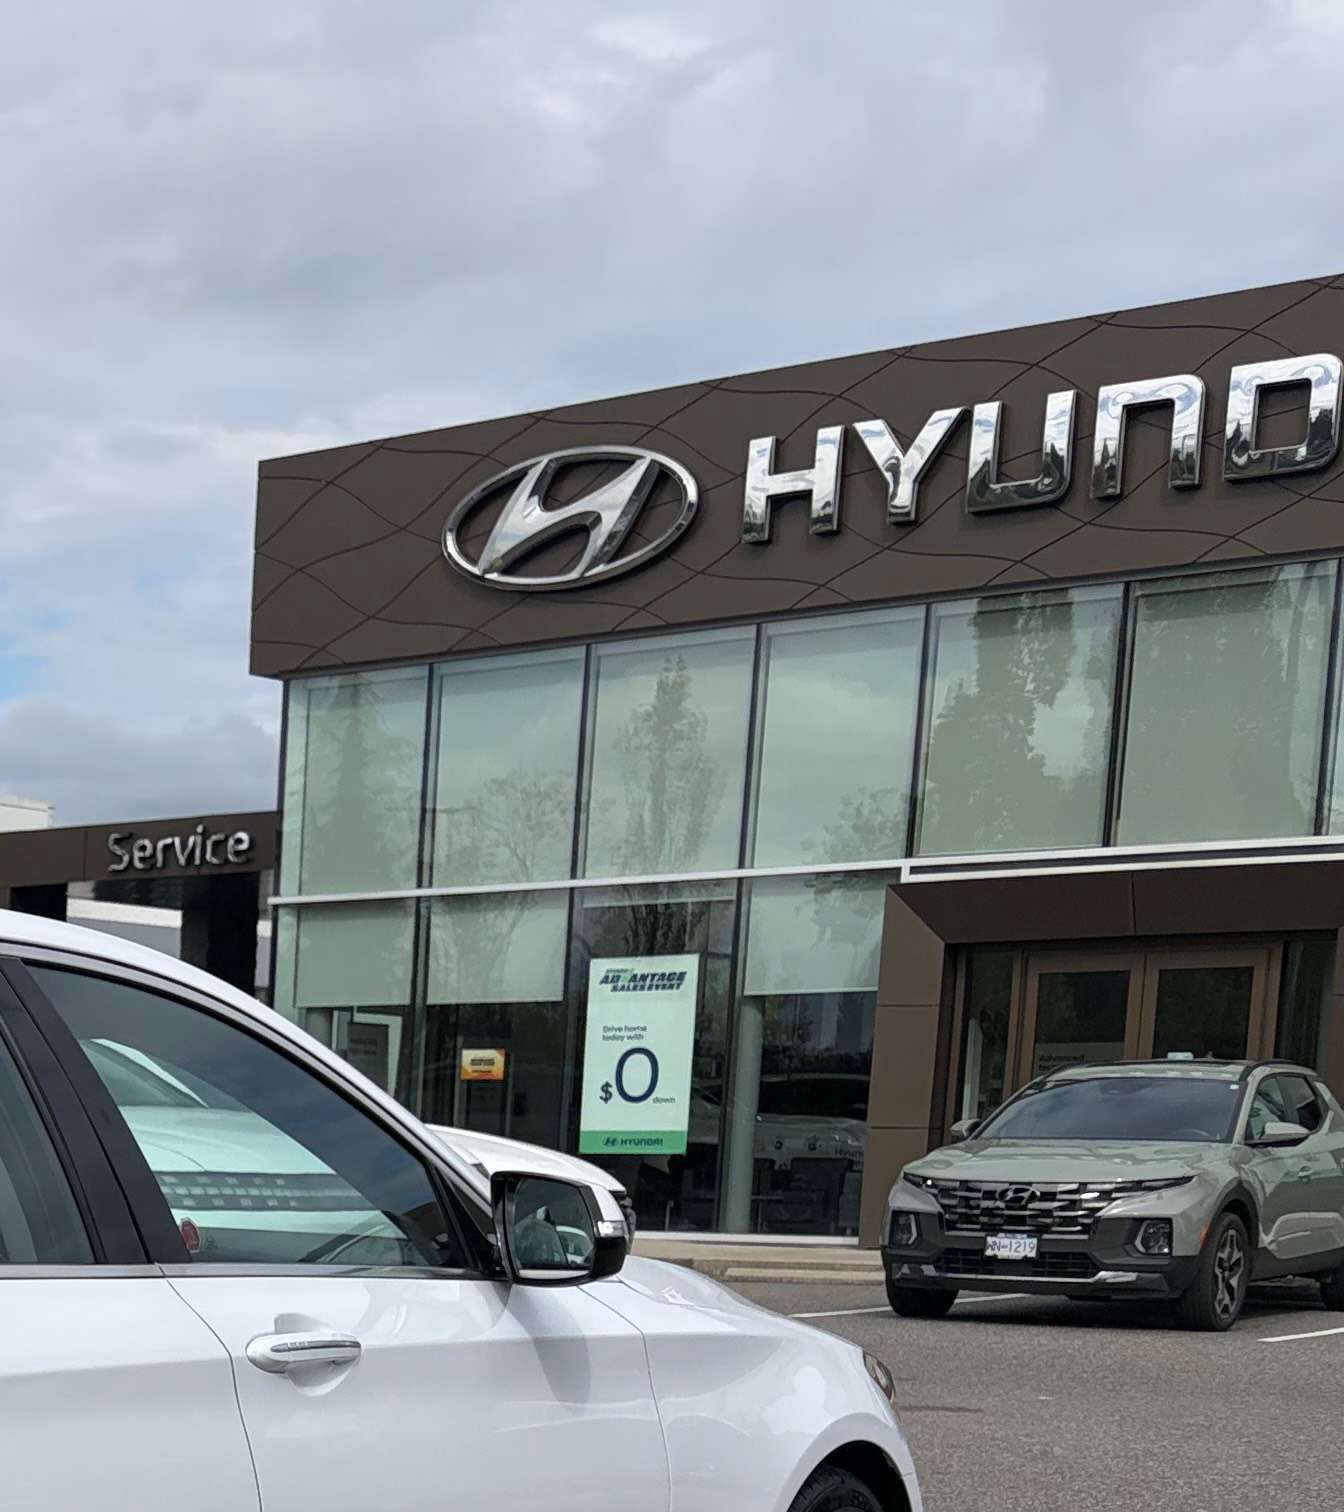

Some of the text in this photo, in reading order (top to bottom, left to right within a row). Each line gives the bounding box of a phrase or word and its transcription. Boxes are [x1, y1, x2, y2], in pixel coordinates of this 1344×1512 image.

[741, 353, 1343, 543] HYUND
[107, 823, 250, 872] Service
[620, 1138, 663, 1147] HYUNDAI
